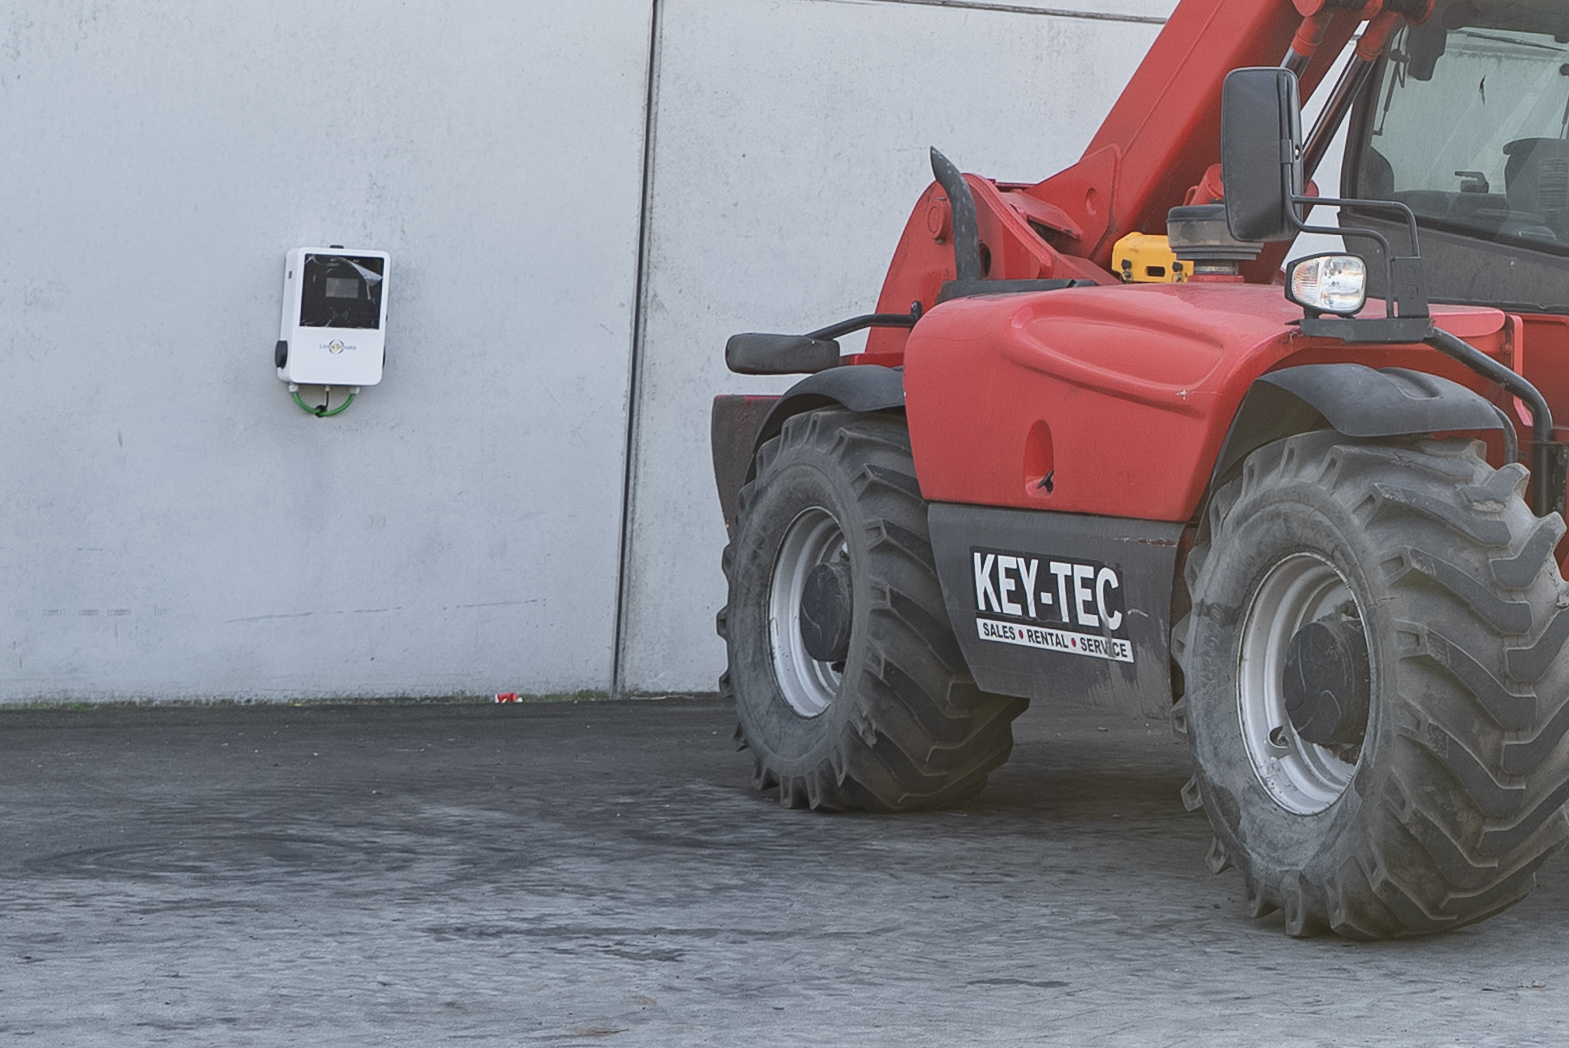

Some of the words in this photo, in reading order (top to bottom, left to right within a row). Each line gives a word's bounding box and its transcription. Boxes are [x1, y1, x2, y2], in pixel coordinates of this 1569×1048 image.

[973, 552, 1123, 631] KEY-TEC
[983, 622, 1016, 641] SALES
[1027, 630, 1069, 649] RENTAL
[1080, 636, 1128, 658] SERVCE
